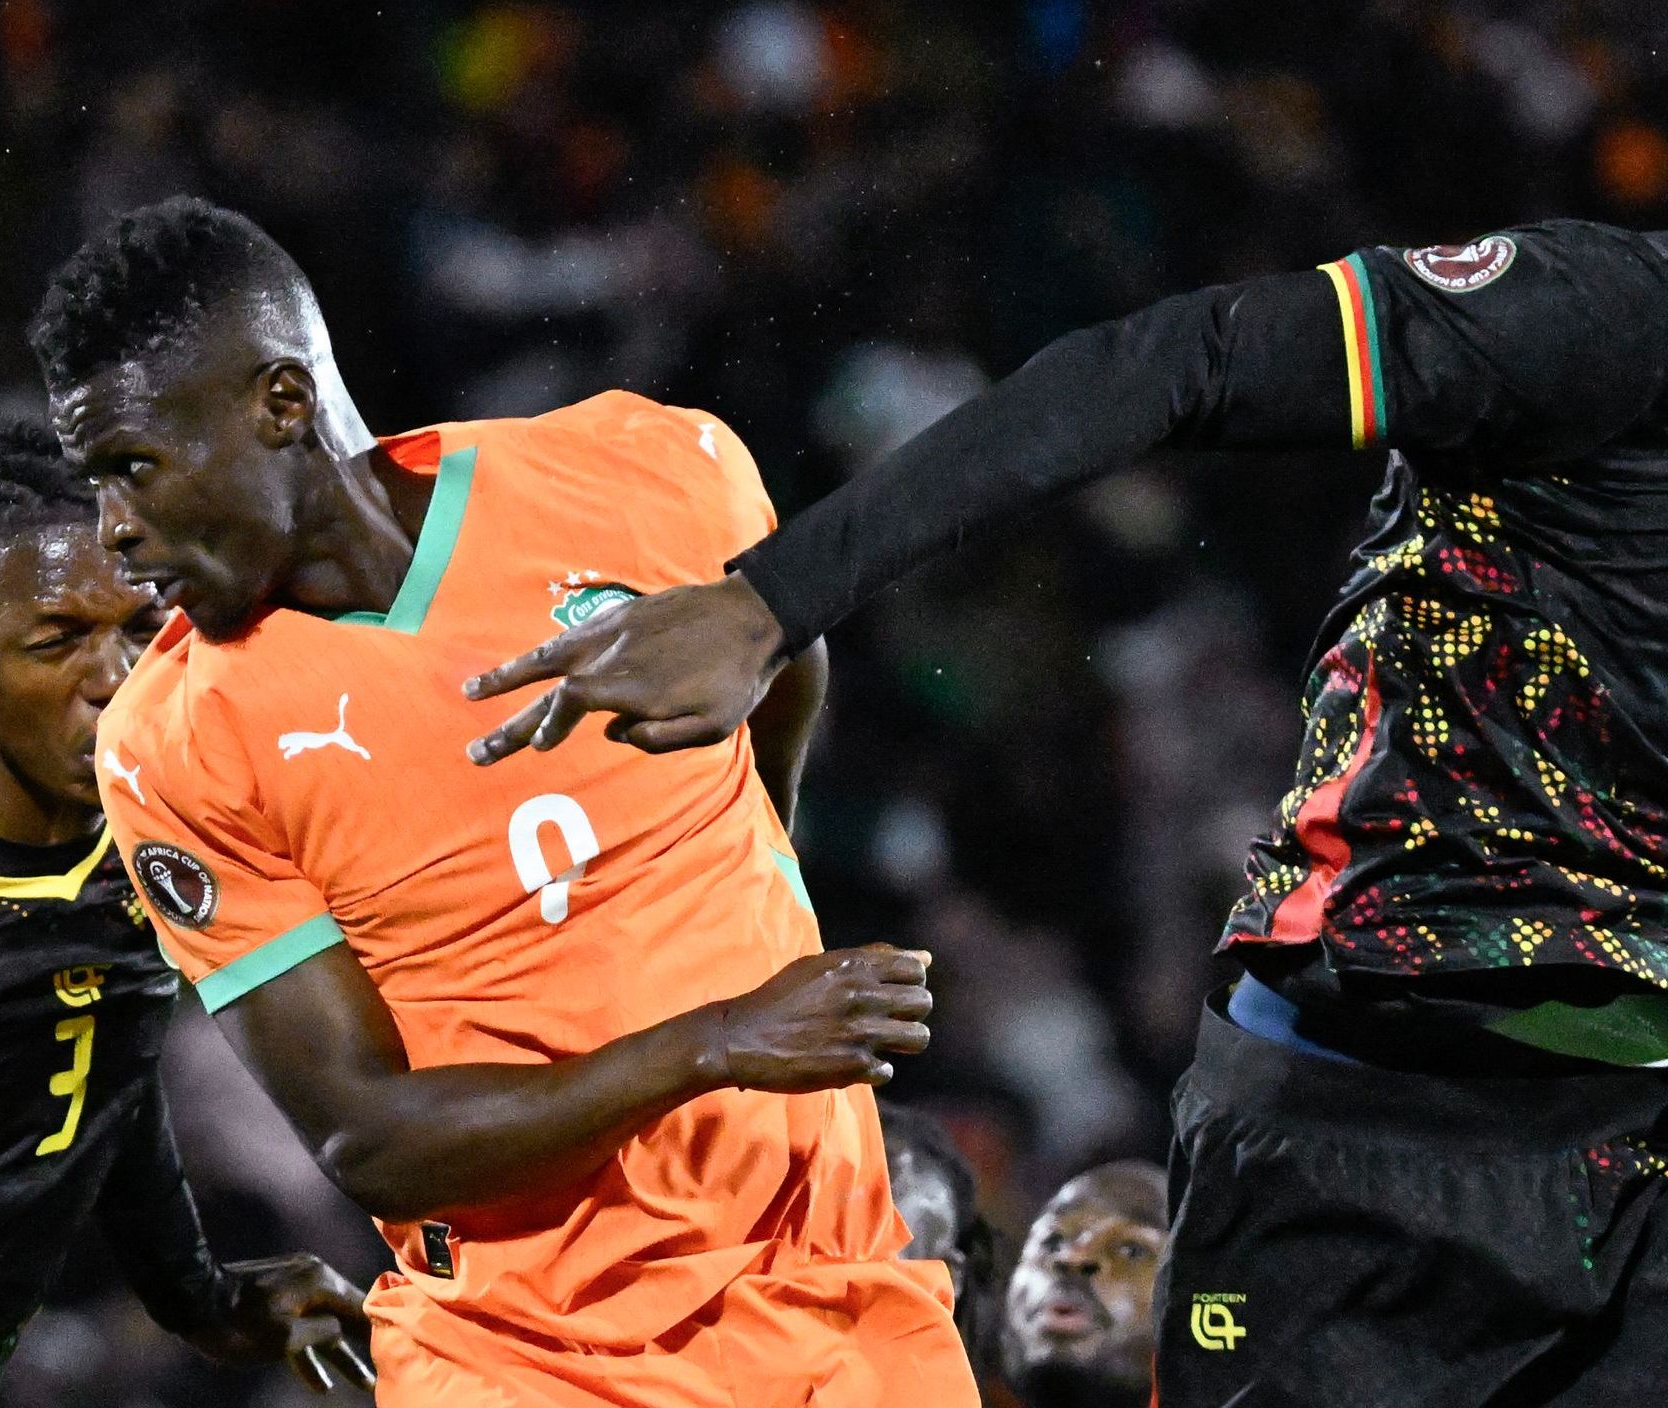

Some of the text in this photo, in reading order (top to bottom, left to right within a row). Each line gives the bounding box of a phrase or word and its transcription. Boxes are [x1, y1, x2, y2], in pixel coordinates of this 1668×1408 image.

[147, 847, 180, 861] AFRICA
[180, 855, 201, 872] CUP
[507, 792, 601, 925] 9
[35, 1014, 96, 1157] 3
